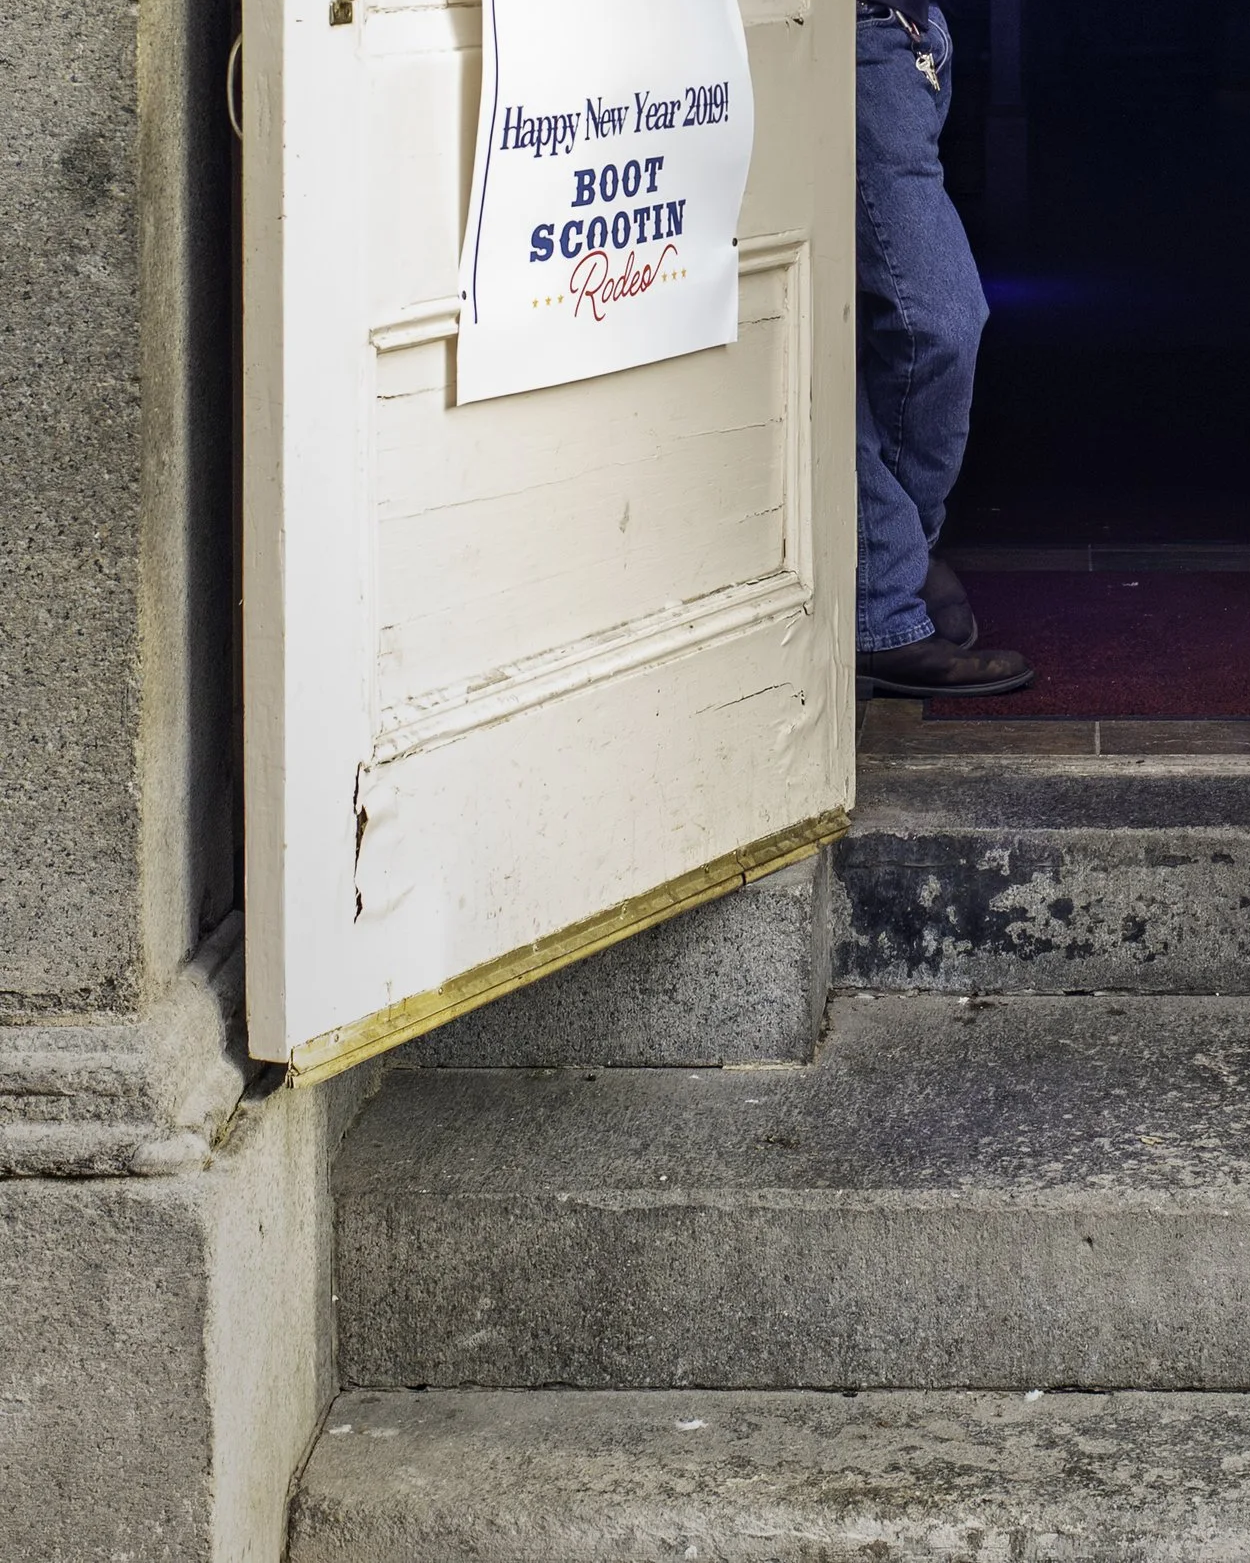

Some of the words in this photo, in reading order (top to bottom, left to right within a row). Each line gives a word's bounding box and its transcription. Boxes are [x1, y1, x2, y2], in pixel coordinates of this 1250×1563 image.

[500, 105, 581, 158] Happy
[584, 96, 630, 141] New
[633, 90, 682, 134] Year
[683, 81, 730, 128] 2019!
[571, 155, 665, 208] BOOT
[529, 198, 687, 263] SCOOTIN
[569, 243, 679, 322] Rodeo
